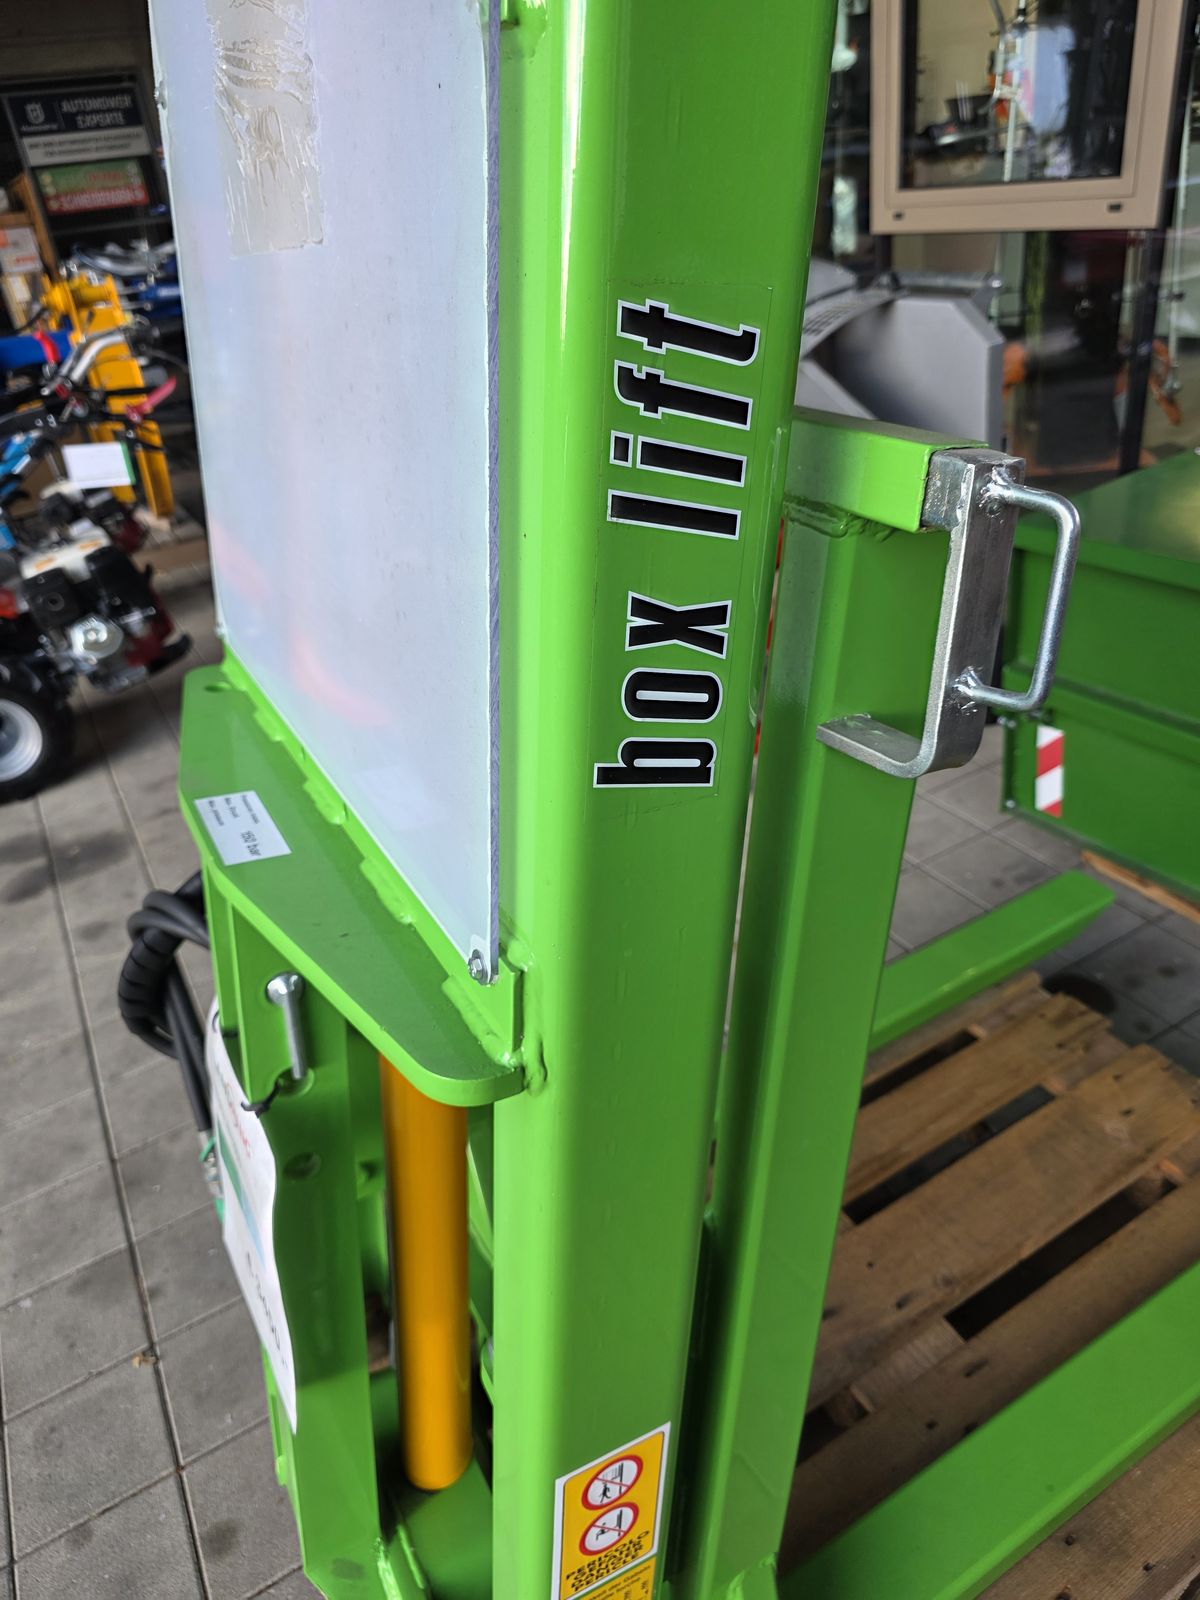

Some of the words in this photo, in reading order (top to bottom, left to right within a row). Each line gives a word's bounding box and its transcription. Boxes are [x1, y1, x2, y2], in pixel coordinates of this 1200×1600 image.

[607, 298, 760, 540] lift
[593, 591, 732, 789] box
[566, 1530, 650, 1580] PERICOLO
[571, 1545, 643, 1589] DANGER
[573, 1538, 643, 1581] GEFAHR
